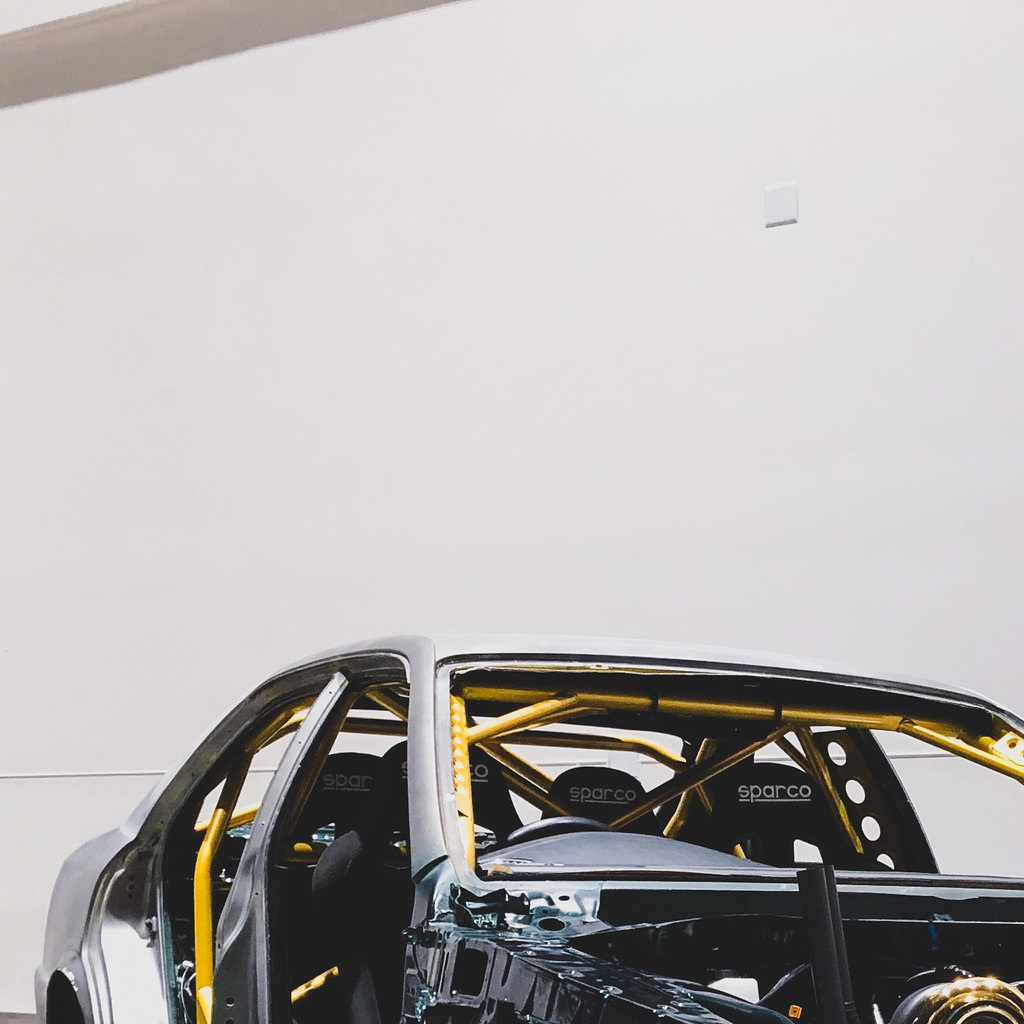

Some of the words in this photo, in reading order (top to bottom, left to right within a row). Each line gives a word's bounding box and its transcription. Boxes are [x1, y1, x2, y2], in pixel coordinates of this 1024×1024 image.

[323, 773, 373, 791] spar
[569, 786, 636, 804] sparco
[738, 784, 812, 803] sparco
